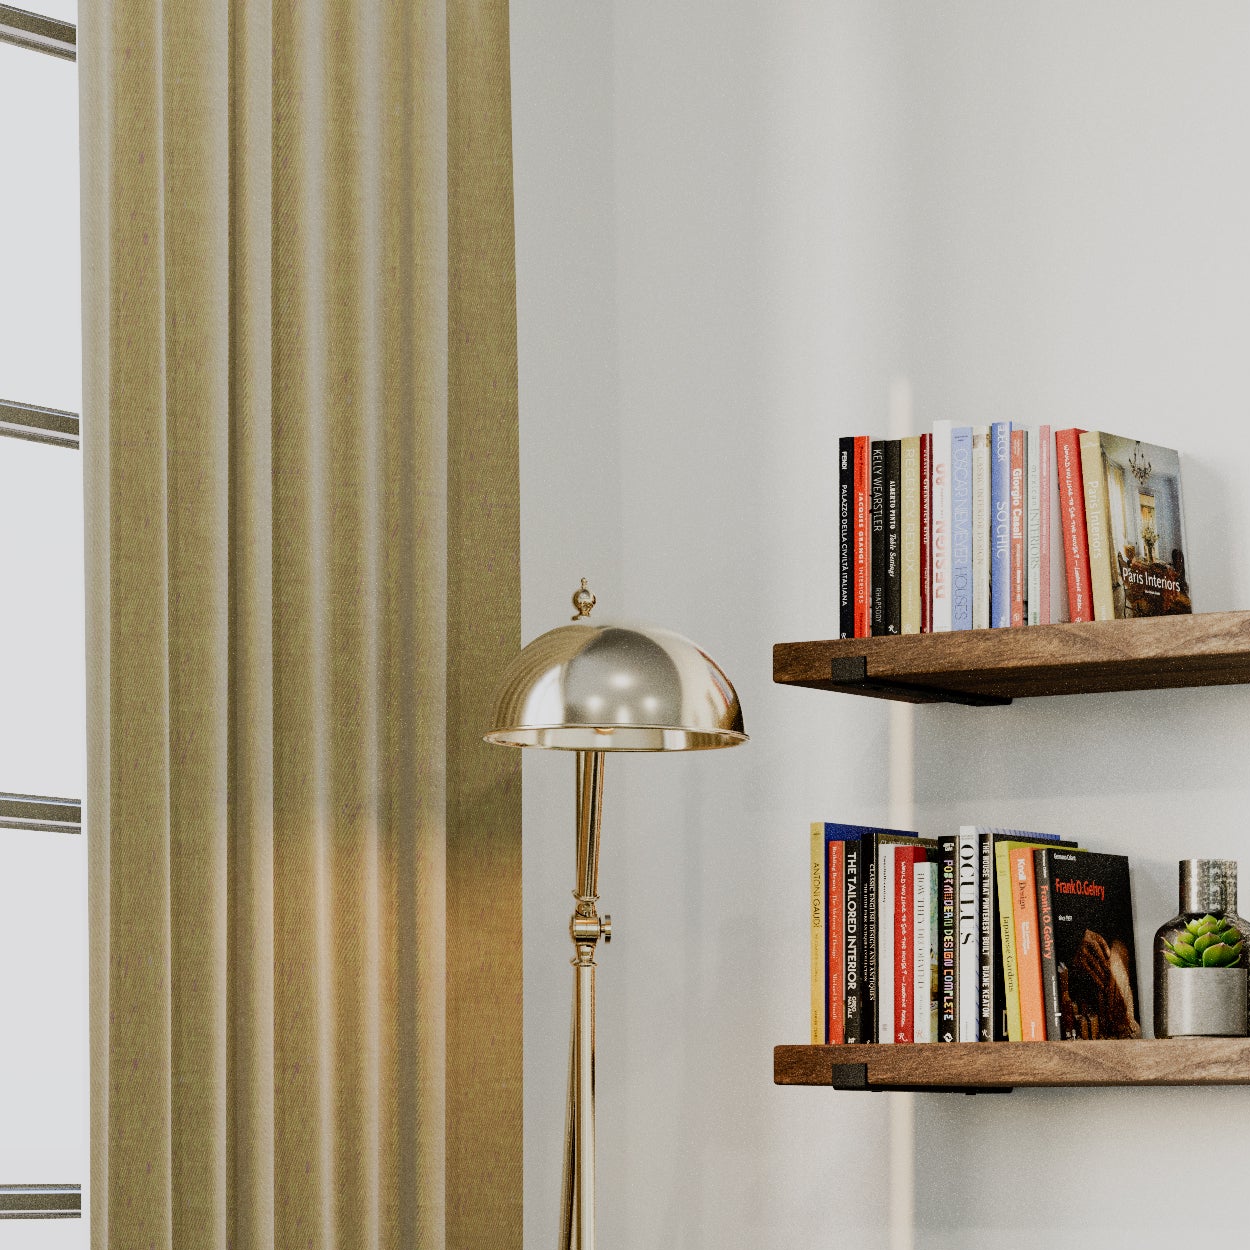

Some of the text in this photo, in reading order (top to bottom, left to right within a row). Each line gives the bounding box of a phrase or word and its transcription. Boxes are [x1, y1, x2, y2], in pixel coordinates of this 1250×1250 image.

[841, 451, 849, 470] FENDI
[906, 449, 915, 518] REGENCY
[954, 448, 967, 497] OSCAR
[873, 450, 883, 532] KELLY WEARSTLER
[1011, 468, 1022, 506] Giorgio
[954, 500, 967, 563] NIEMEYER
[996, 501, 1010, 559] SO CHIC
[1012, 508, 1022, 539] Casali
[1088, 481, 1103, 559] Paris Interiors
[841, 484, 850, 606] PALAZZO DELLA CIVILTÀ ITALIANA
[906, 522, 915, 572] REDUX
[935, 519, 946, 599] DESIGN
[954, 566, 967, 621] HOUSES
[1122, 568, 1181, 592] Paris Interiors
[813, 862, 821, 896] ANTONI
[917, 873, 925, 895] HOW
[943, 859, 954, 927] POSTMODERN
[960, 843, 974, 945] OCULUS
[1017, 858, 1027, 881] Knoll
[1055, 878, 1105, 902] Frank Gehry
[813, 898, 822, 928] GAUDÍ
[917, 899, 925, 924] THEY
[1018, 881, 1027, 910] Design
[1040, 885, 1049, 914] Frank
[847, 851, 857, 990] THE TAILORED INTERIOR
[982, 842, 990, 1018] THE HOUSE THAT PINTEREST BUILT DIANE KEATON
[1043, 925, 1053, 959] Gehry
[943, 929, 954, 966] DESIGN
[1002, 915, 1014, 992] Japanese Gardens
[943, 969, 954, 1021] COMPLETE
